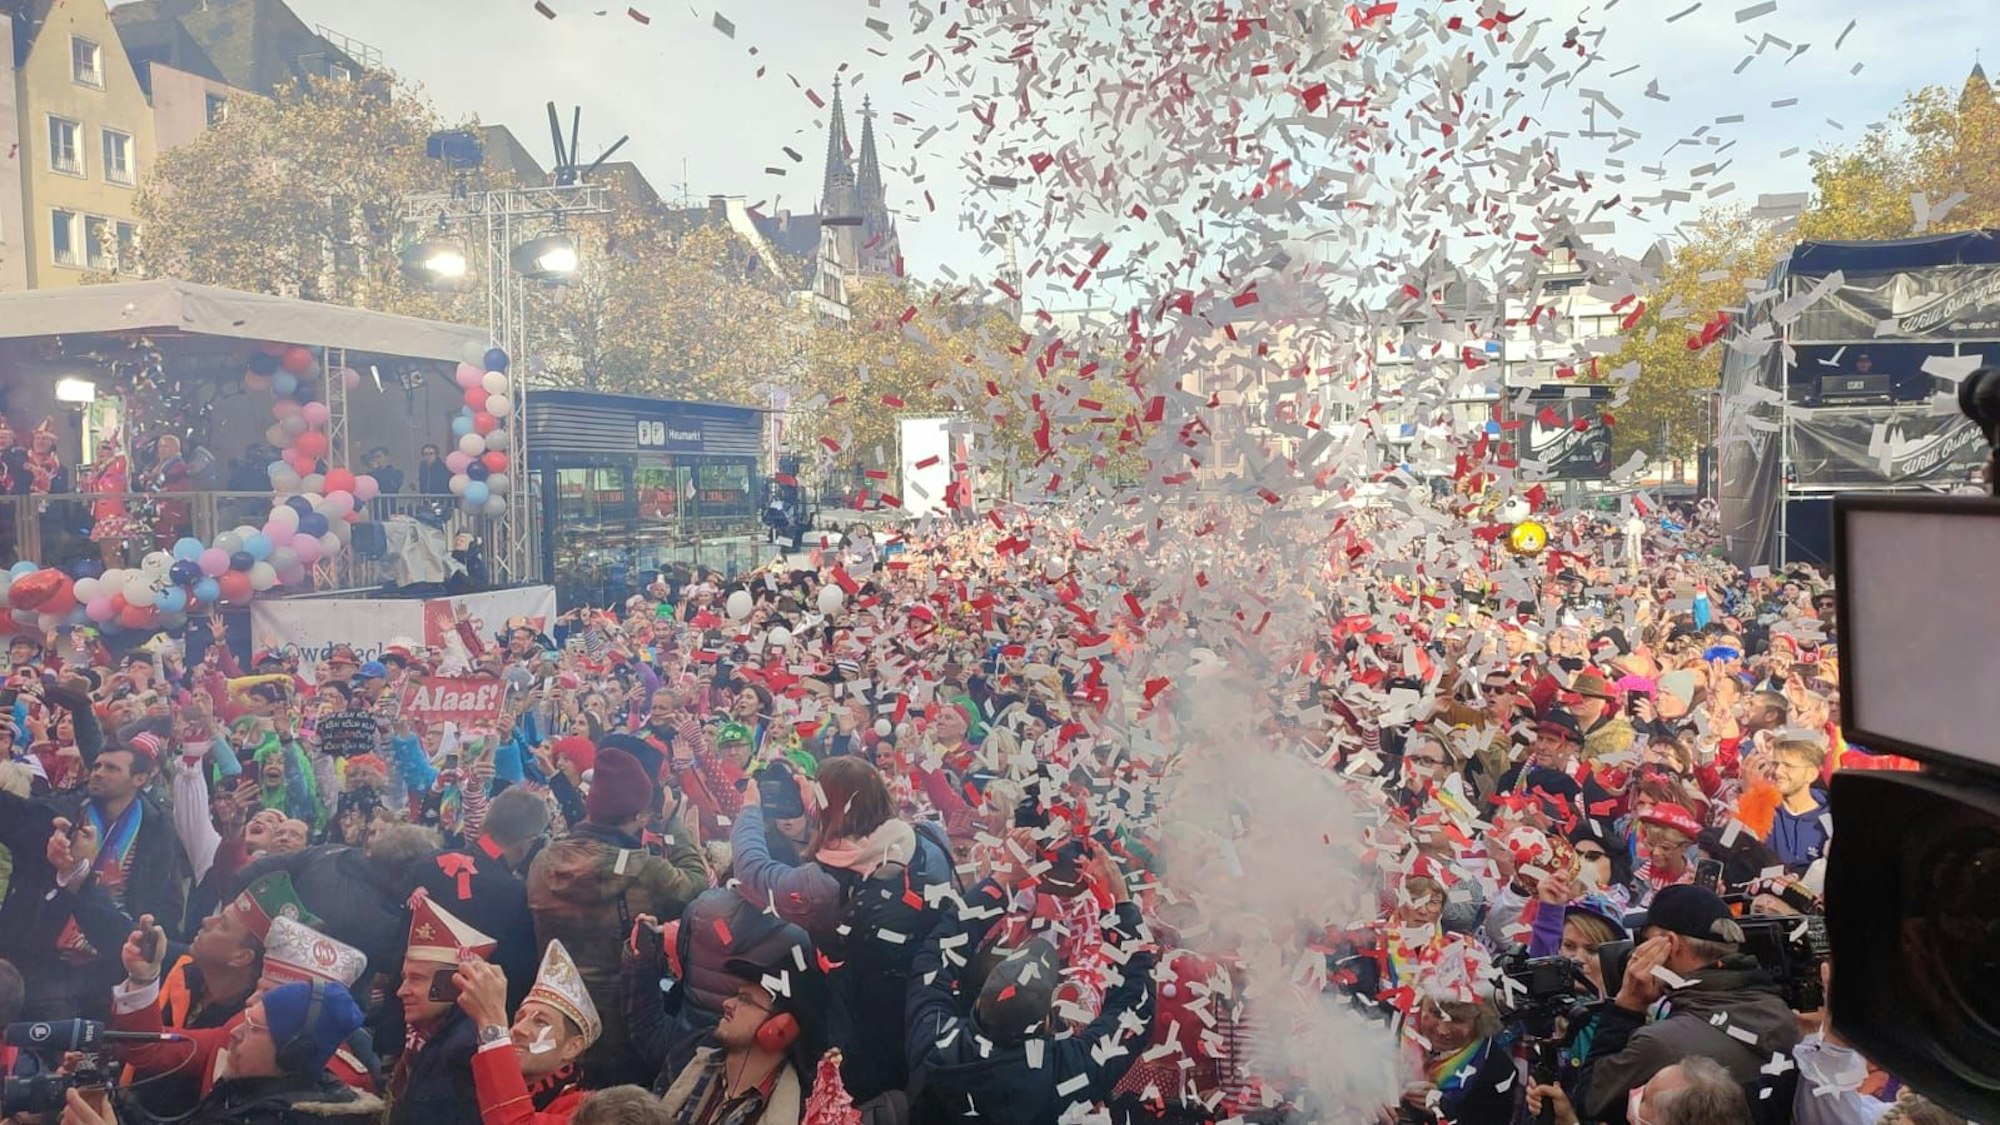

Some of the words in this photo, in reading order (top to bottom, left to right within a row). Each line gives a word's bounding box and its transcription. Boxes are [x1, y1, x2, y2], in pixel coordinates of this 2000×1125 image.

[669, 429, 701, 441] Heumarkt
[1902, 447, 1941, 475] Willi
[407, 684, 499, 712] Alaaf!
